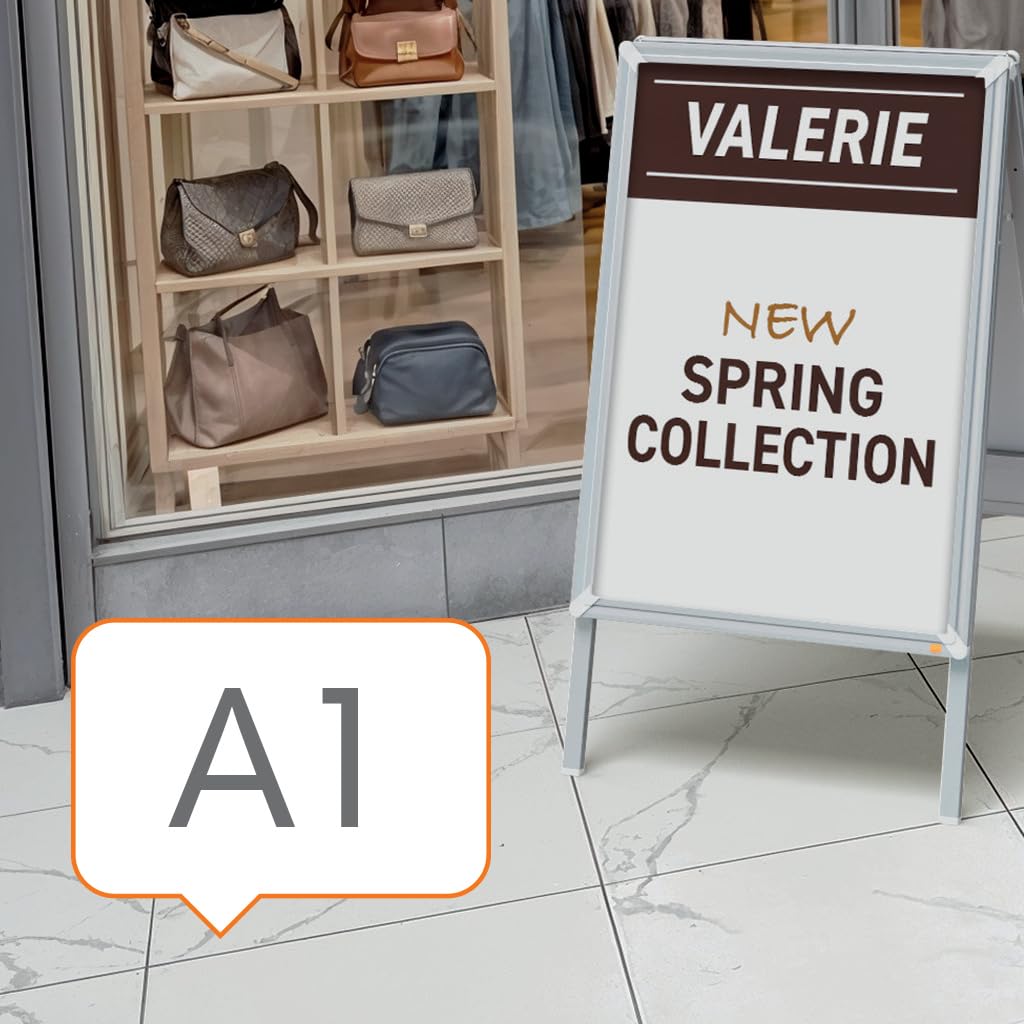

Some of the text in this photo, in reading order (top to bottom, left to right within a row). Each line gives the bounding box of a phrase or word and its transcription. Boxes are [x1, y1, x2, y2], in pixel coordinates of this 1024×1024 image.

[687, 101, 931, 169] VALERIE
[722, 300, 858, 347] NEW
[680, 354, 885, 418] SPRING
[627, 414, 937, 488] COLLECTION
